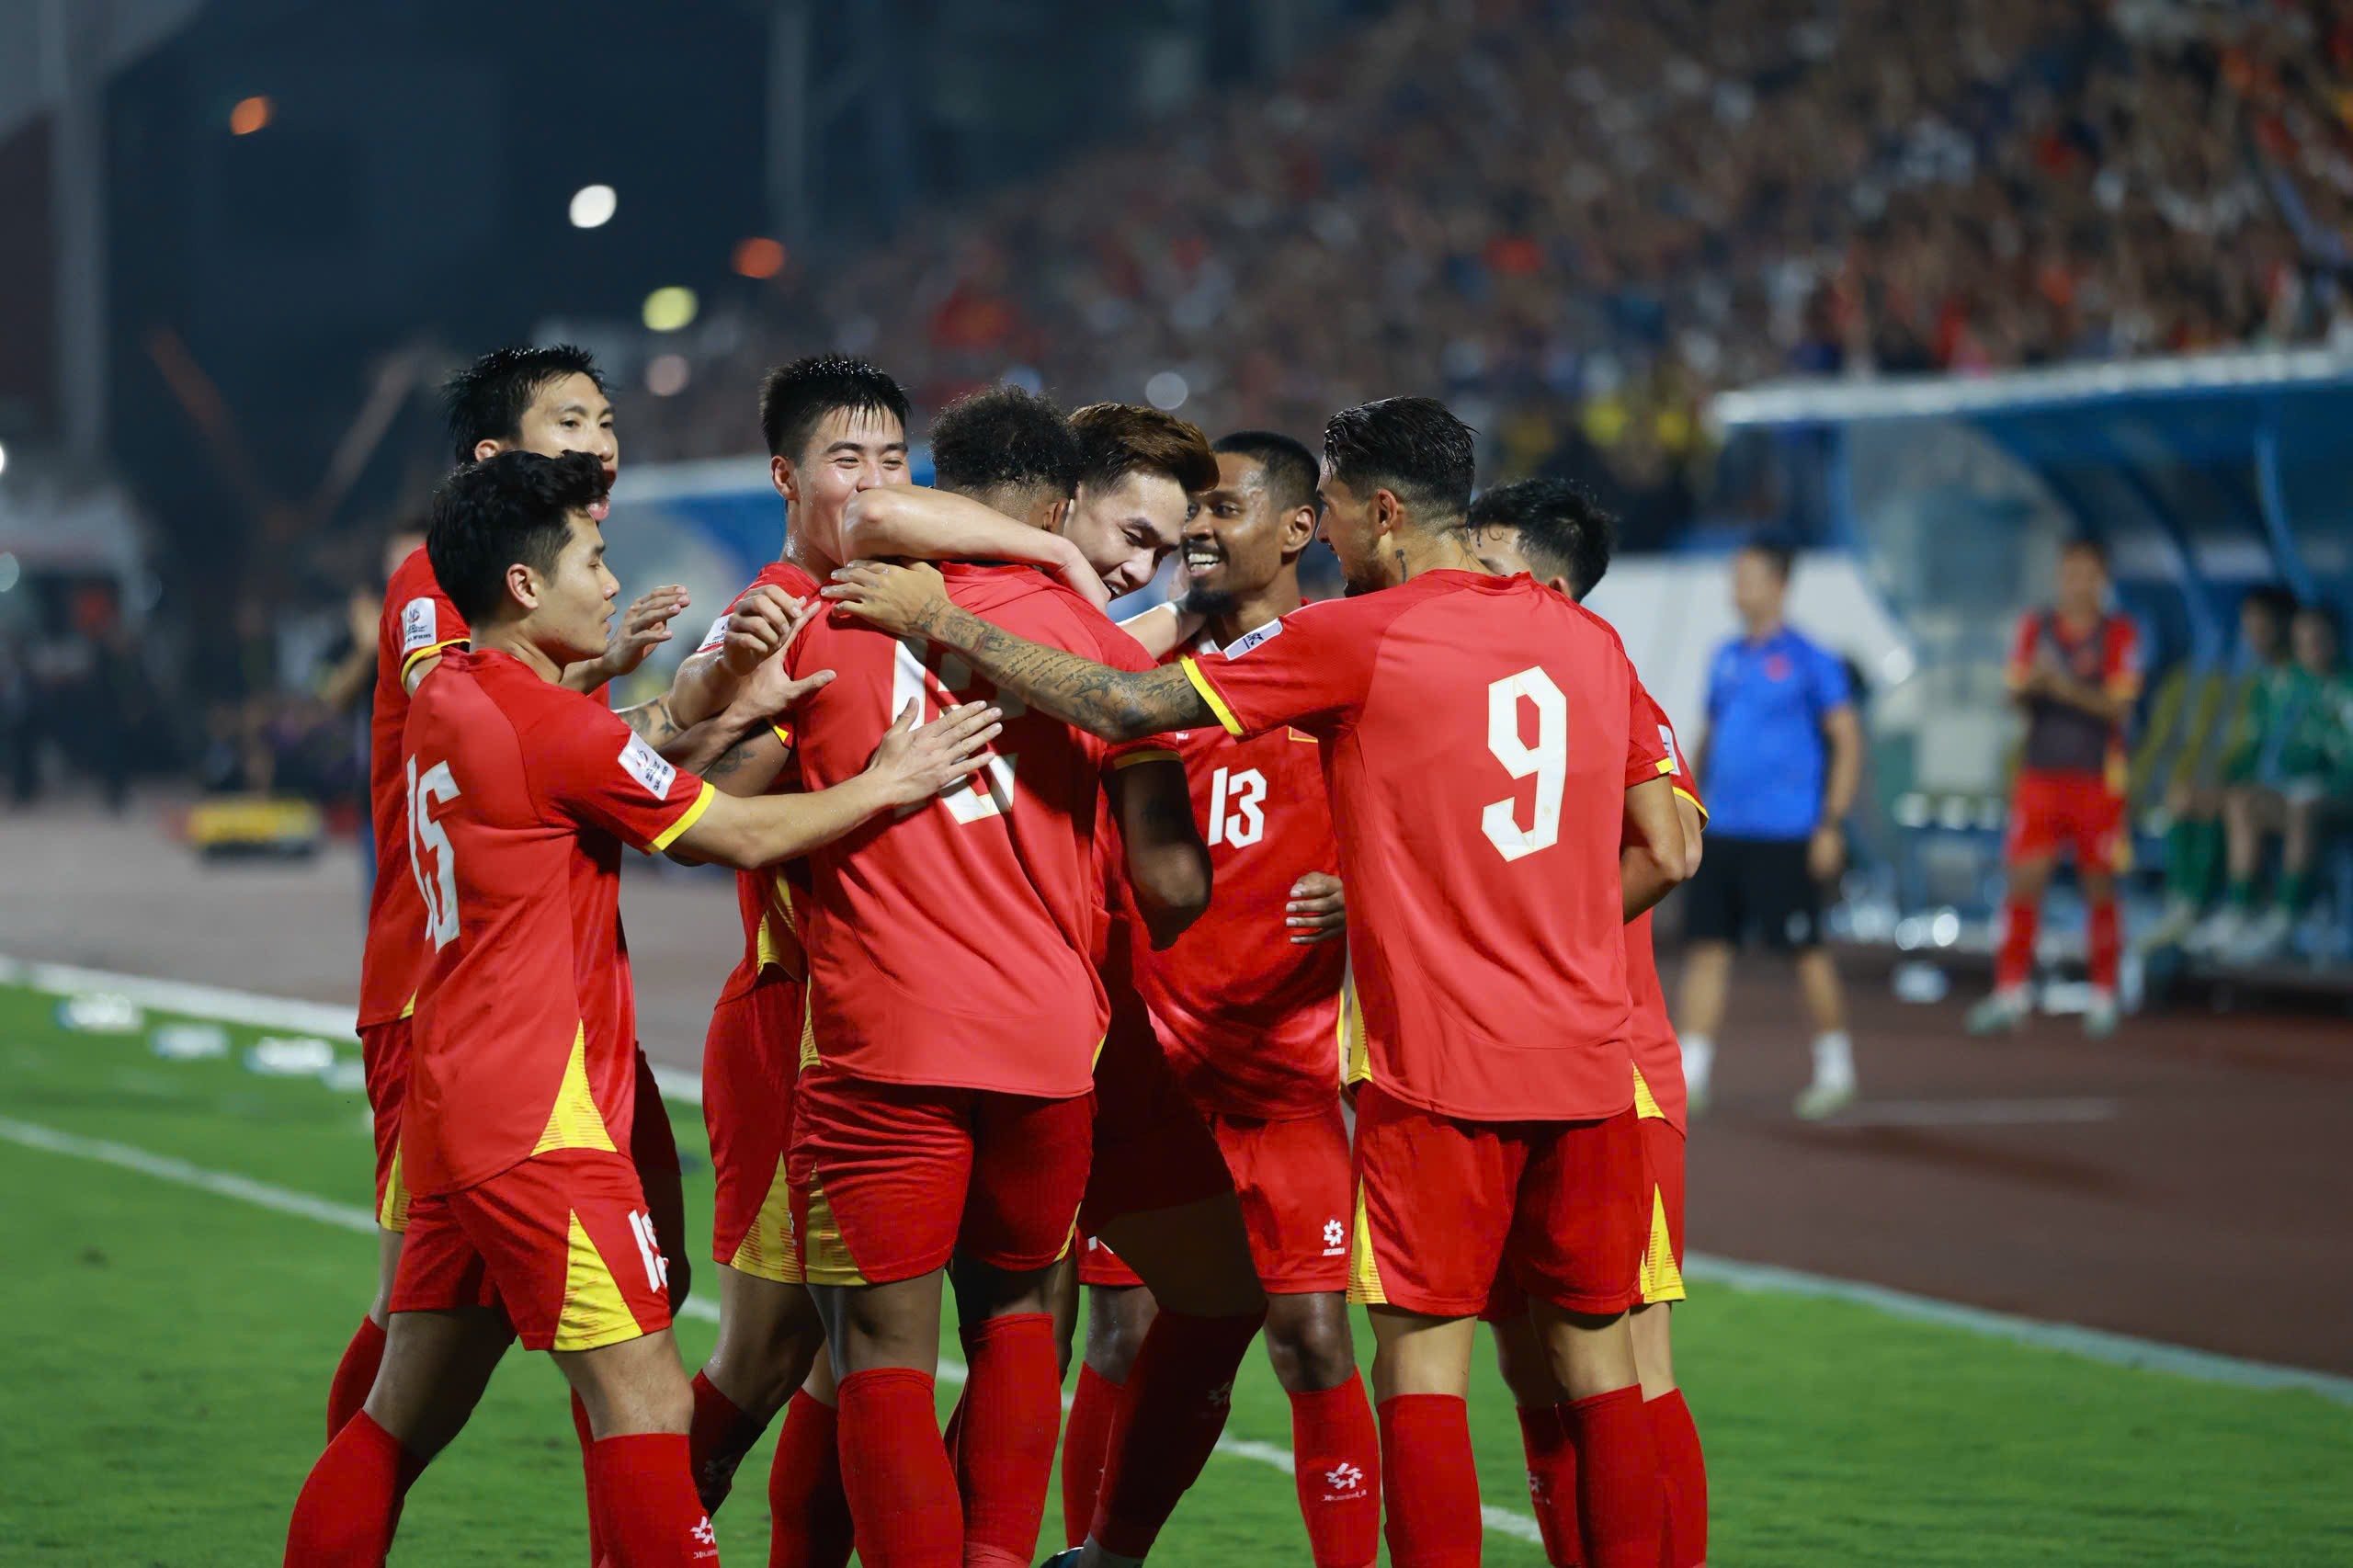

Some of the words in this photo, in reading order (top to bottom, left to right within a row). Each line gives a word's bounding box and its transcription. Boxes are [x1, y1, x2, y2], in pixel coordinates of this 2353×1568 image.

[406, 752, 461, 955] 15
[1208, 767, 1267, 849] 13
[1481, 665, 1567, 862] 9
